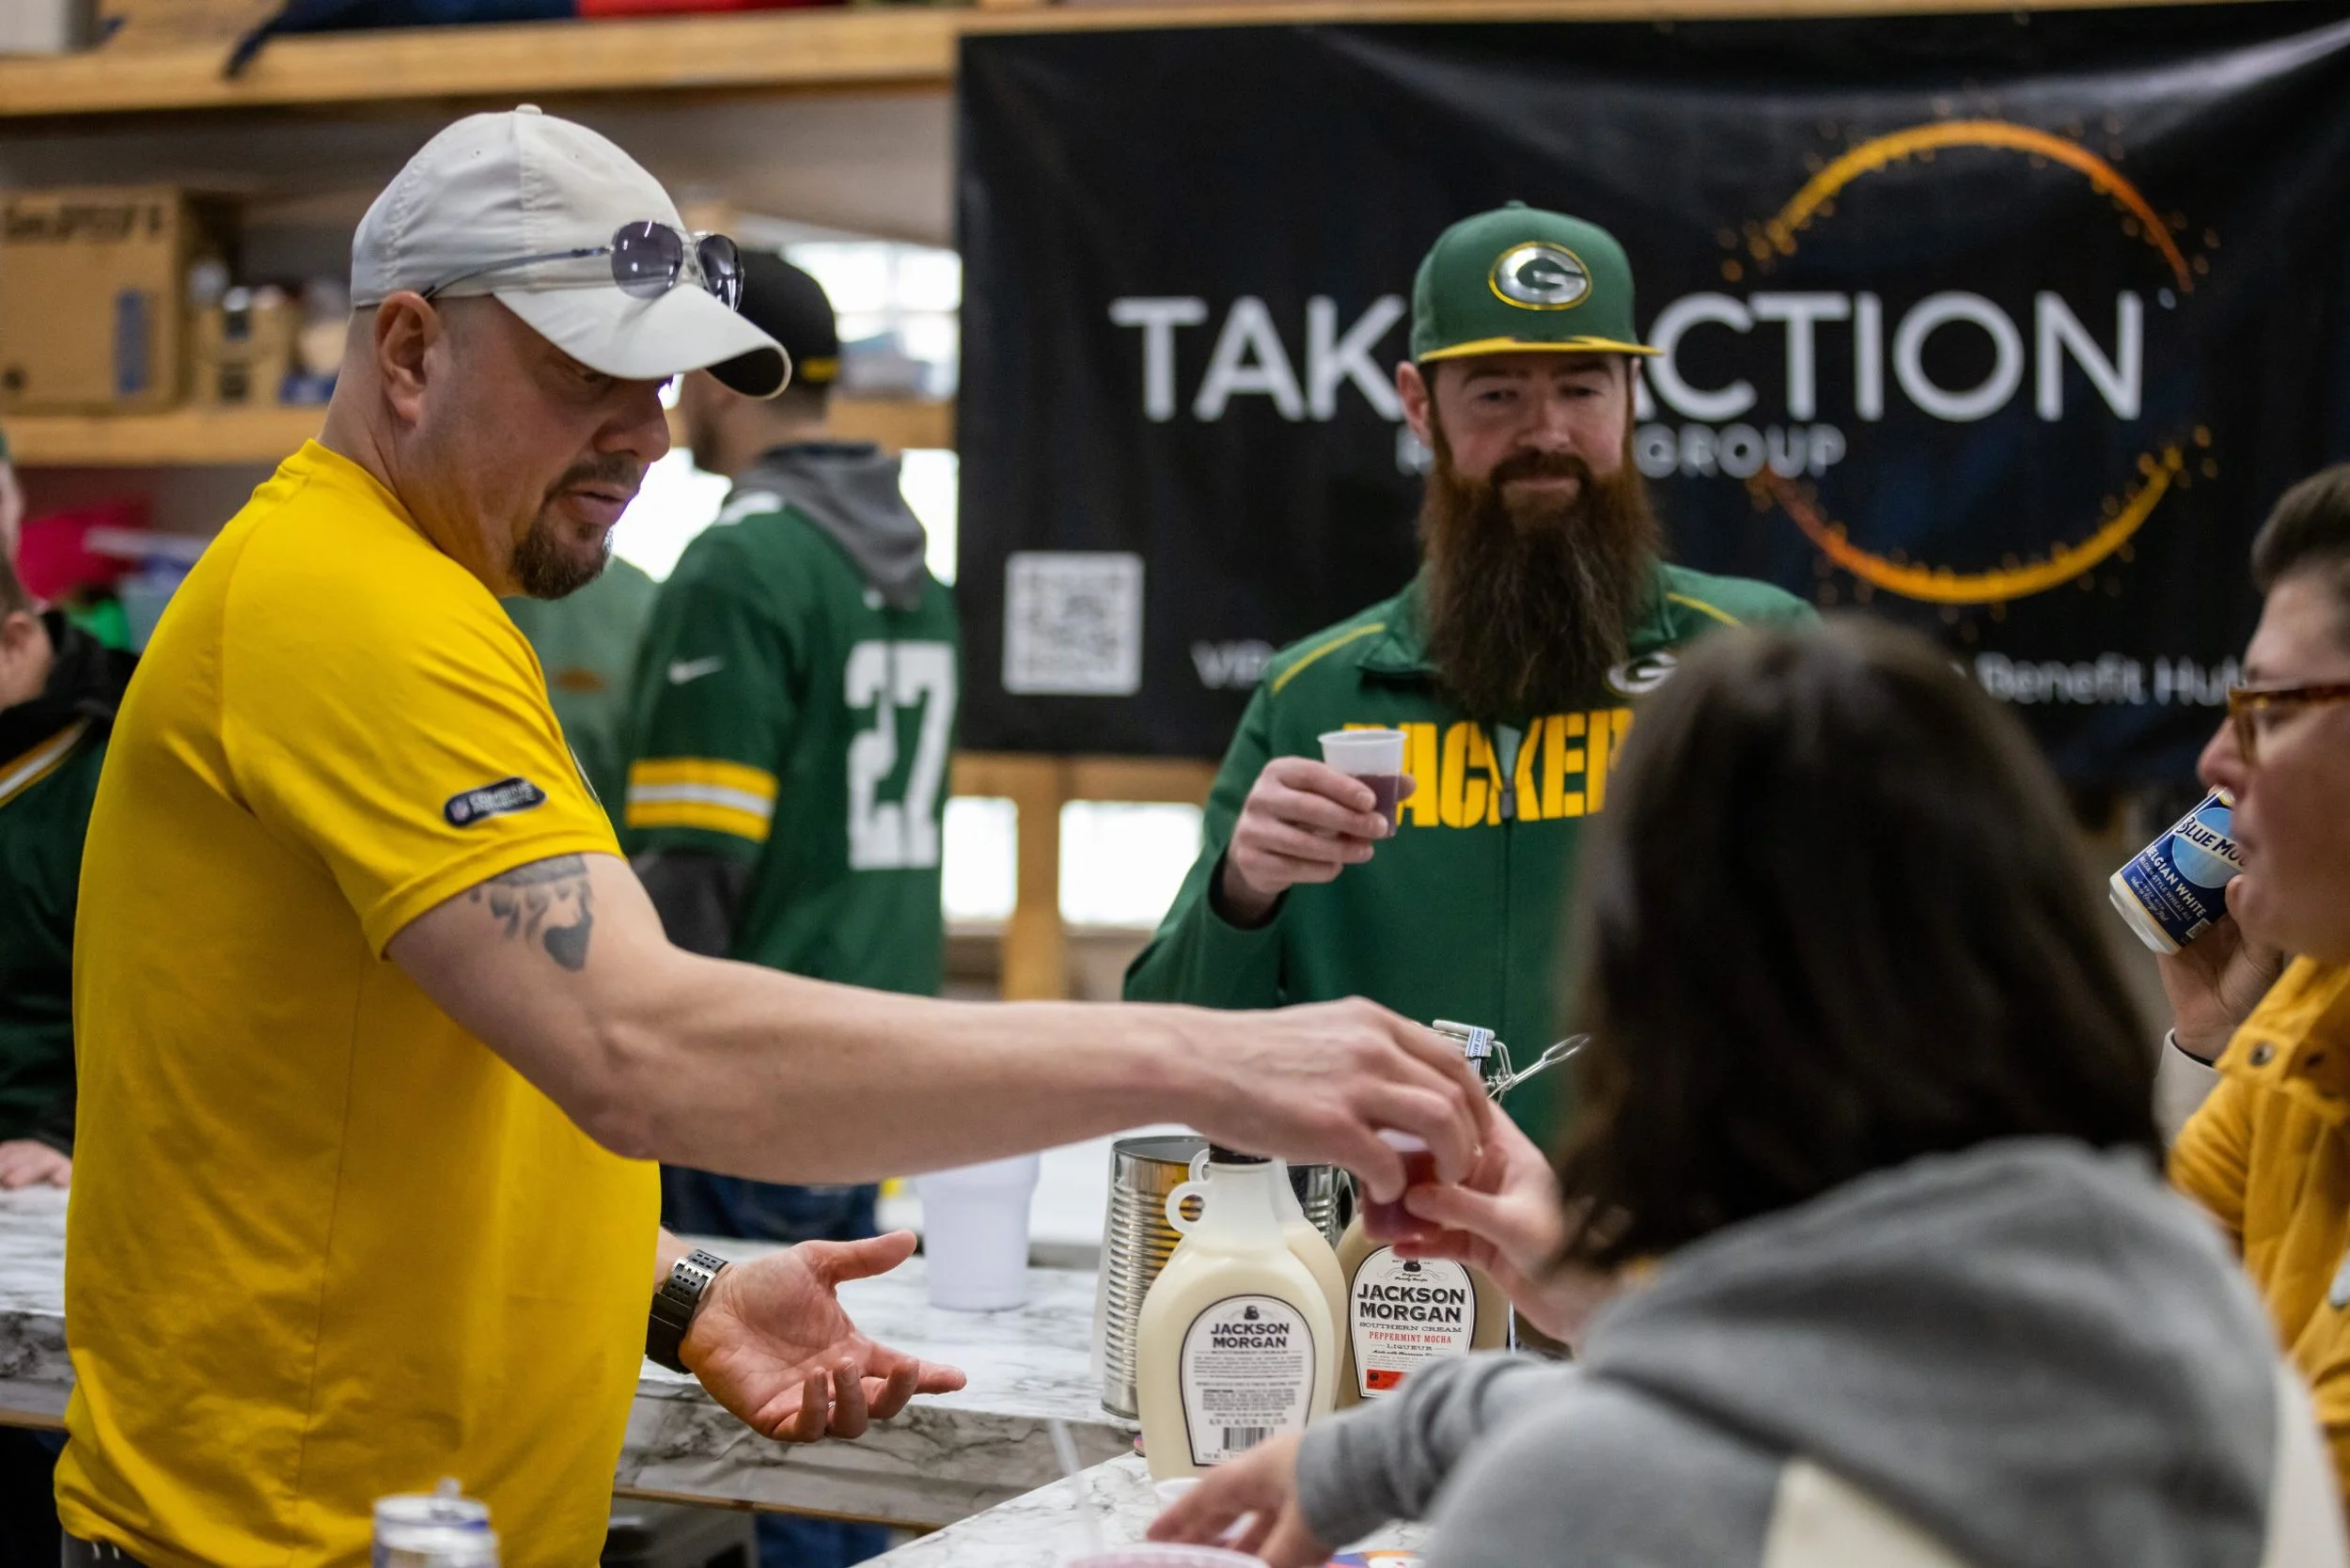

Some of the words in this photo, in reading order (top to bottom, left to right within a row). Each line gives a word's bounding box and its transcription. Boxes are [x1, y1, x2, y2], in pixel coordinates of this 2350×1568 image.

[1499, 246, 1588, 305] G
[1108, 294, 1408, 422] TAK
[1633, 423, 1846, 478] GROUP
[1976, 652, 2149, 705] Benefit
[845, 640, 957, 870] 27
[2176, 816, 2217, 847] BLUE
[2145, 844, 2178, 886] BELGIAN
[2175, 883, 2207, 917] WHITE
[1357, 1283, 1465, 1305] JACKSON
[1359, 1302, 1462, 1324] MORGAN
[1211, 1323, 1290, 1335] JACKSON
[1359, 1322, 1419, 1331] SOUTHERN
[1369, 1331, 1421, 1342] PEPPERMINT
[1424, 1335, 1452, 1344] MOCHA
[1213, 1336, 1287, 1348] MORGAN
[1386, 1343, 1433, 1352] LIQUEUR
